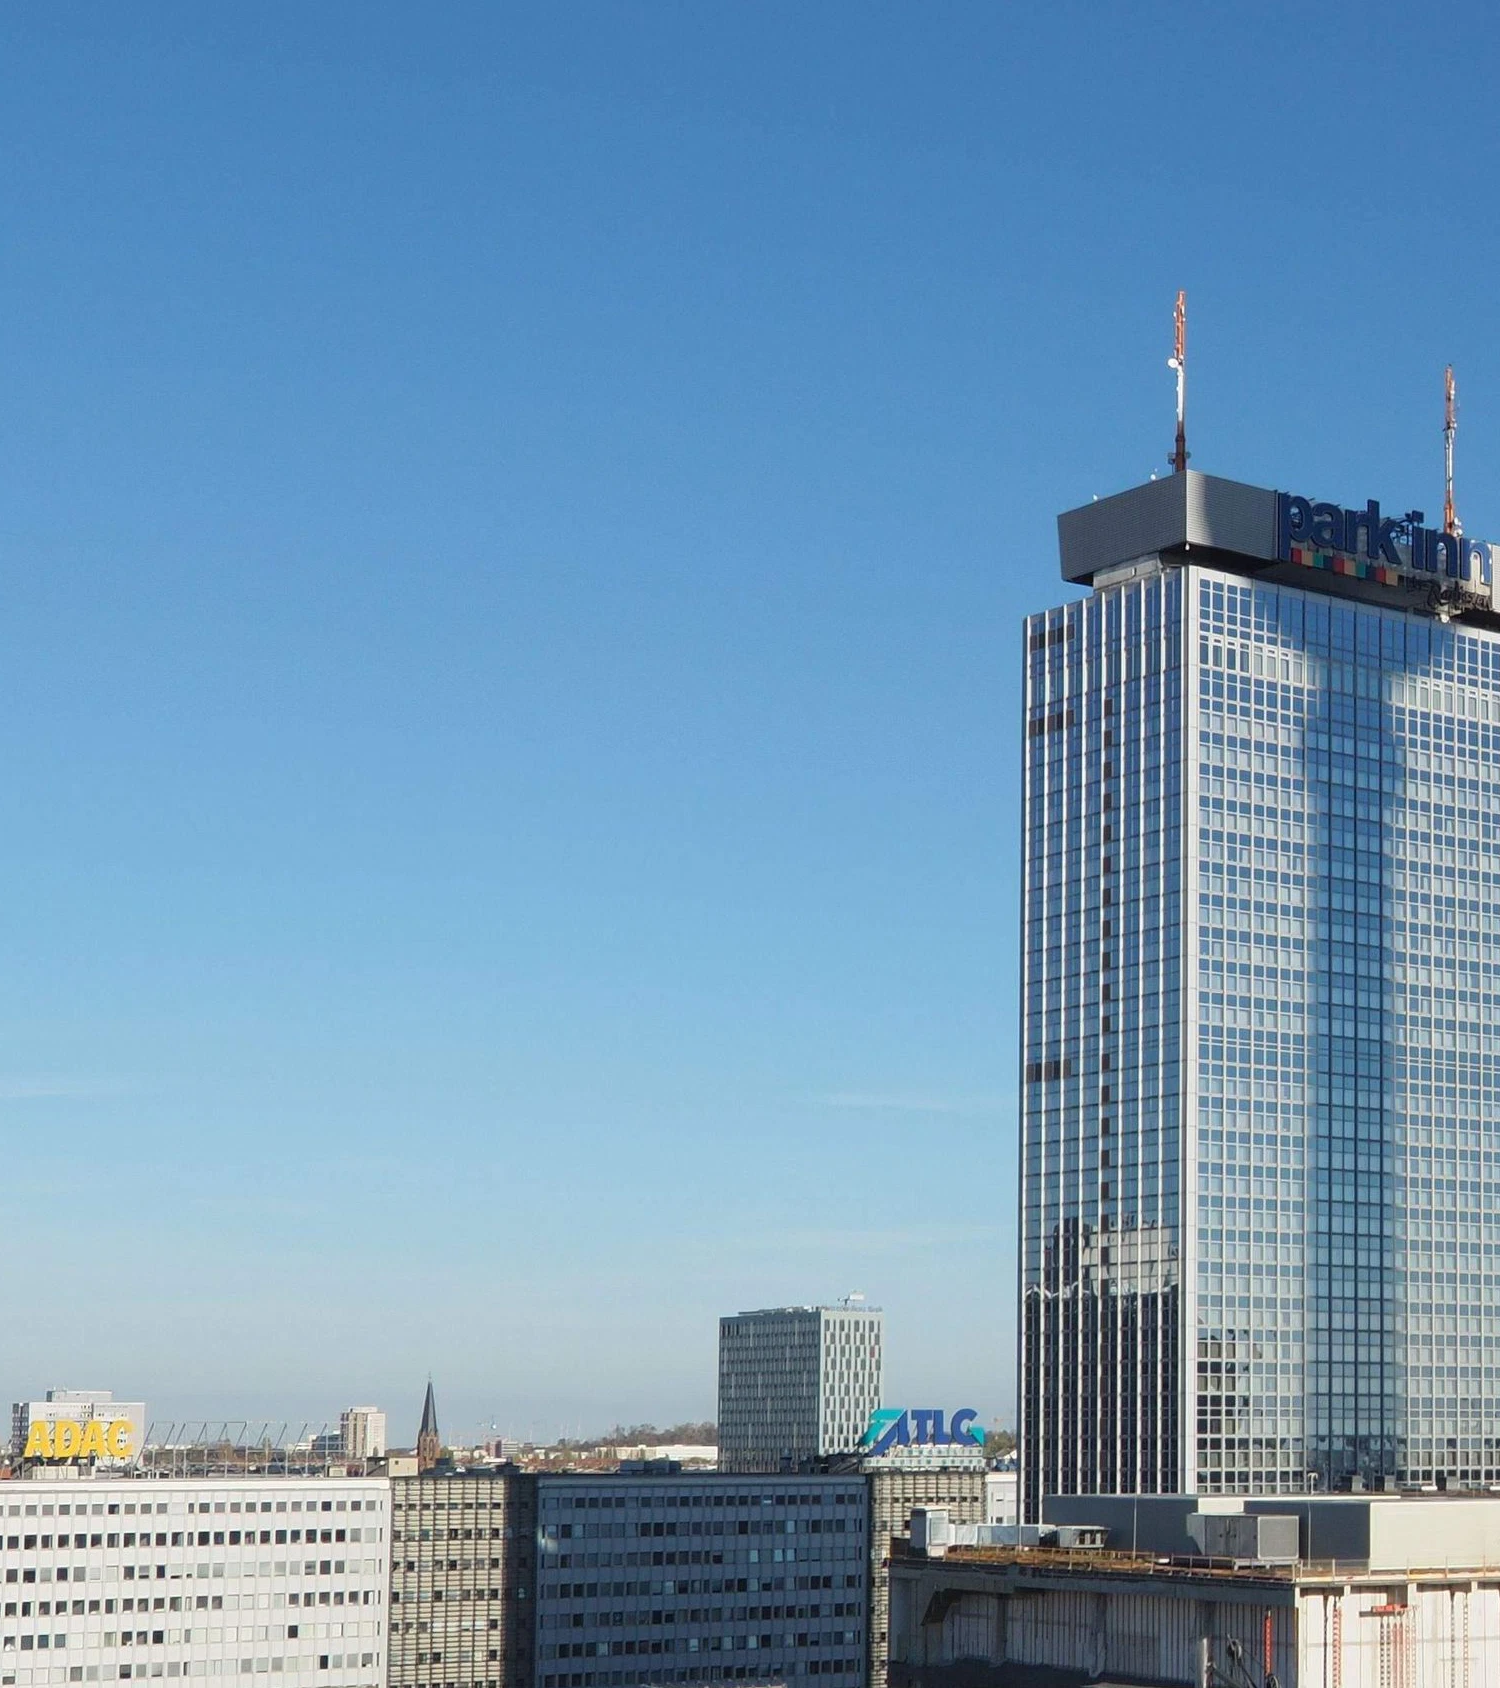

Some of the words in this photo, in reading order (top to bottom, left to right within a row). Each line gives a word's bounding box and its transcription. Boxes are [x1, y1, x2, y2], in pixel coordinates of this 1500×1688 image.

[1278, 490, 1402, 564] park
[1410, 510, 1493, 585] inn
[23, 1419, 134, 1459] ADAC
